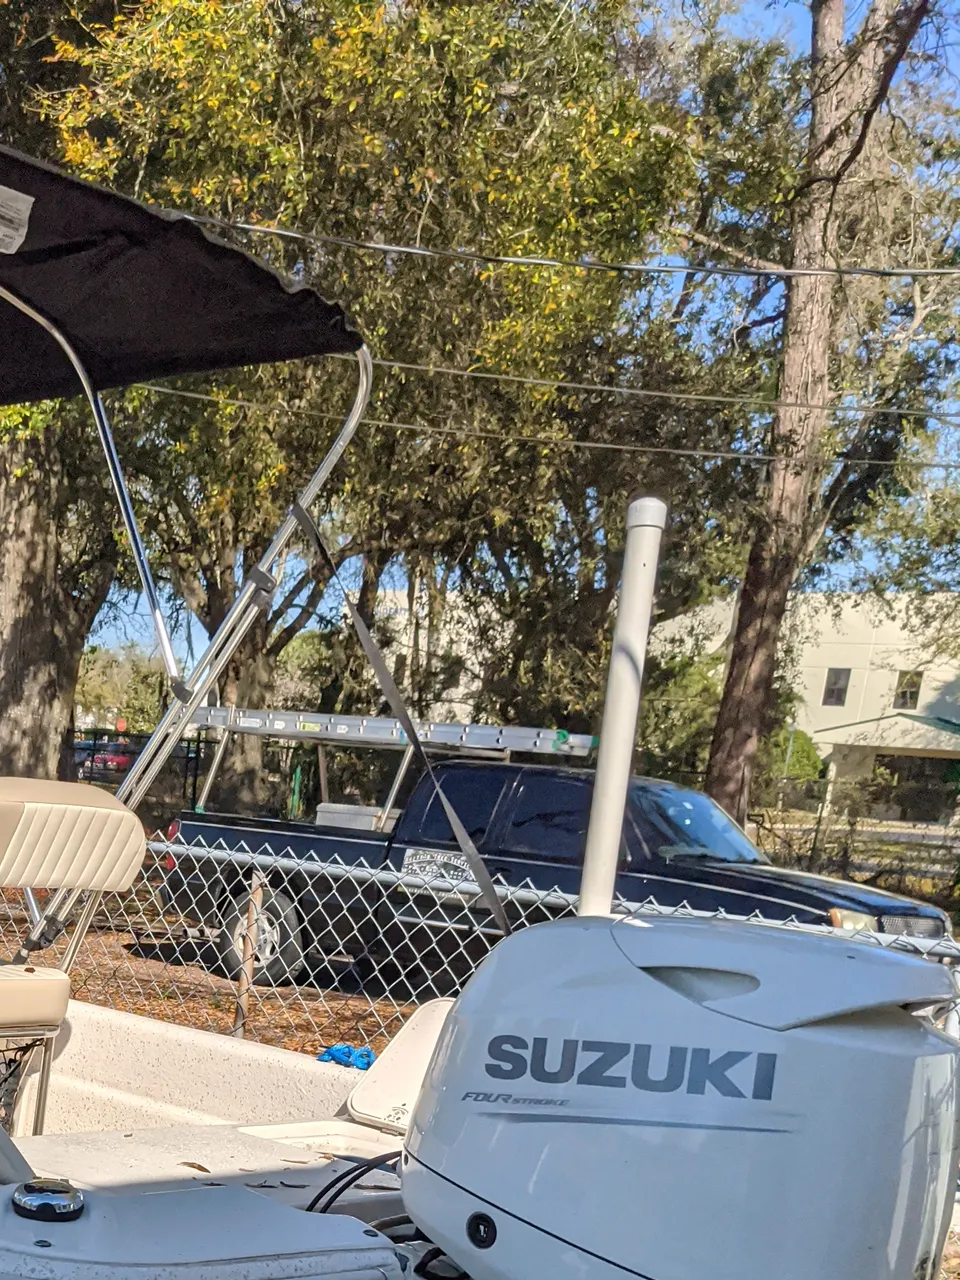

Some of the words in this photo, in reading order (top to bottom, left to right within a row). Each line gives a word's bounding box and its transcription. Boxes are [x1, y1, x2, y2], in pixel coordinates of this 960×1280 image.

[484, 1034, 778, 1101] SUZUKI
[460, 1091, 513, 1105] FOUR
[511, 1097, 570, 1108] STROKE
